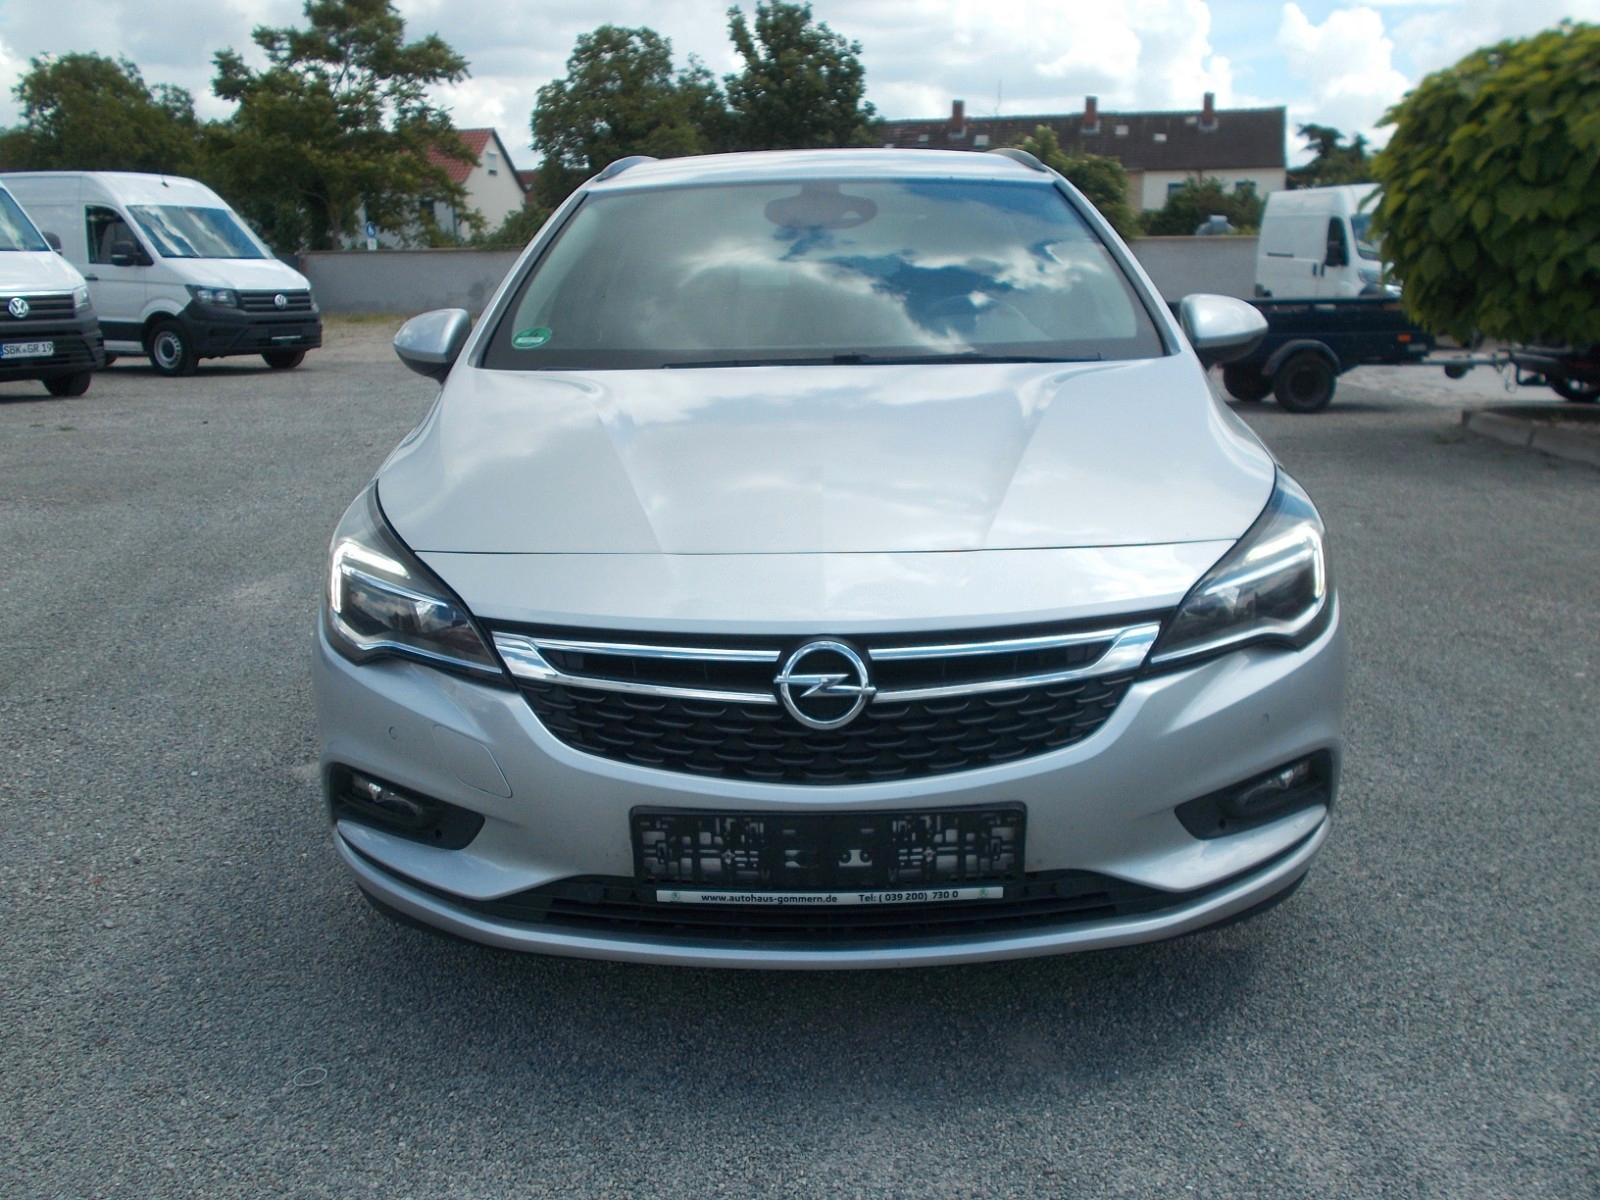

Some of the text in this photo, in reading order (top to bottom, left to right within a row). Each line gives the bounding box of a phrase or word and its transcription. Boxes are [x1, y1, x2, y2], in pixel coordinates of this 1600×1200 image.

[3, 345, 21, 355] SBK
[701, 893, 838, 905] www.autohaus-gommern.de
[858, 893, 877, 902] Tel:
[906, 892, 928, 901] 200)
[932, 891, 950, 900] 730
[952, 890, 959, 898] 0
